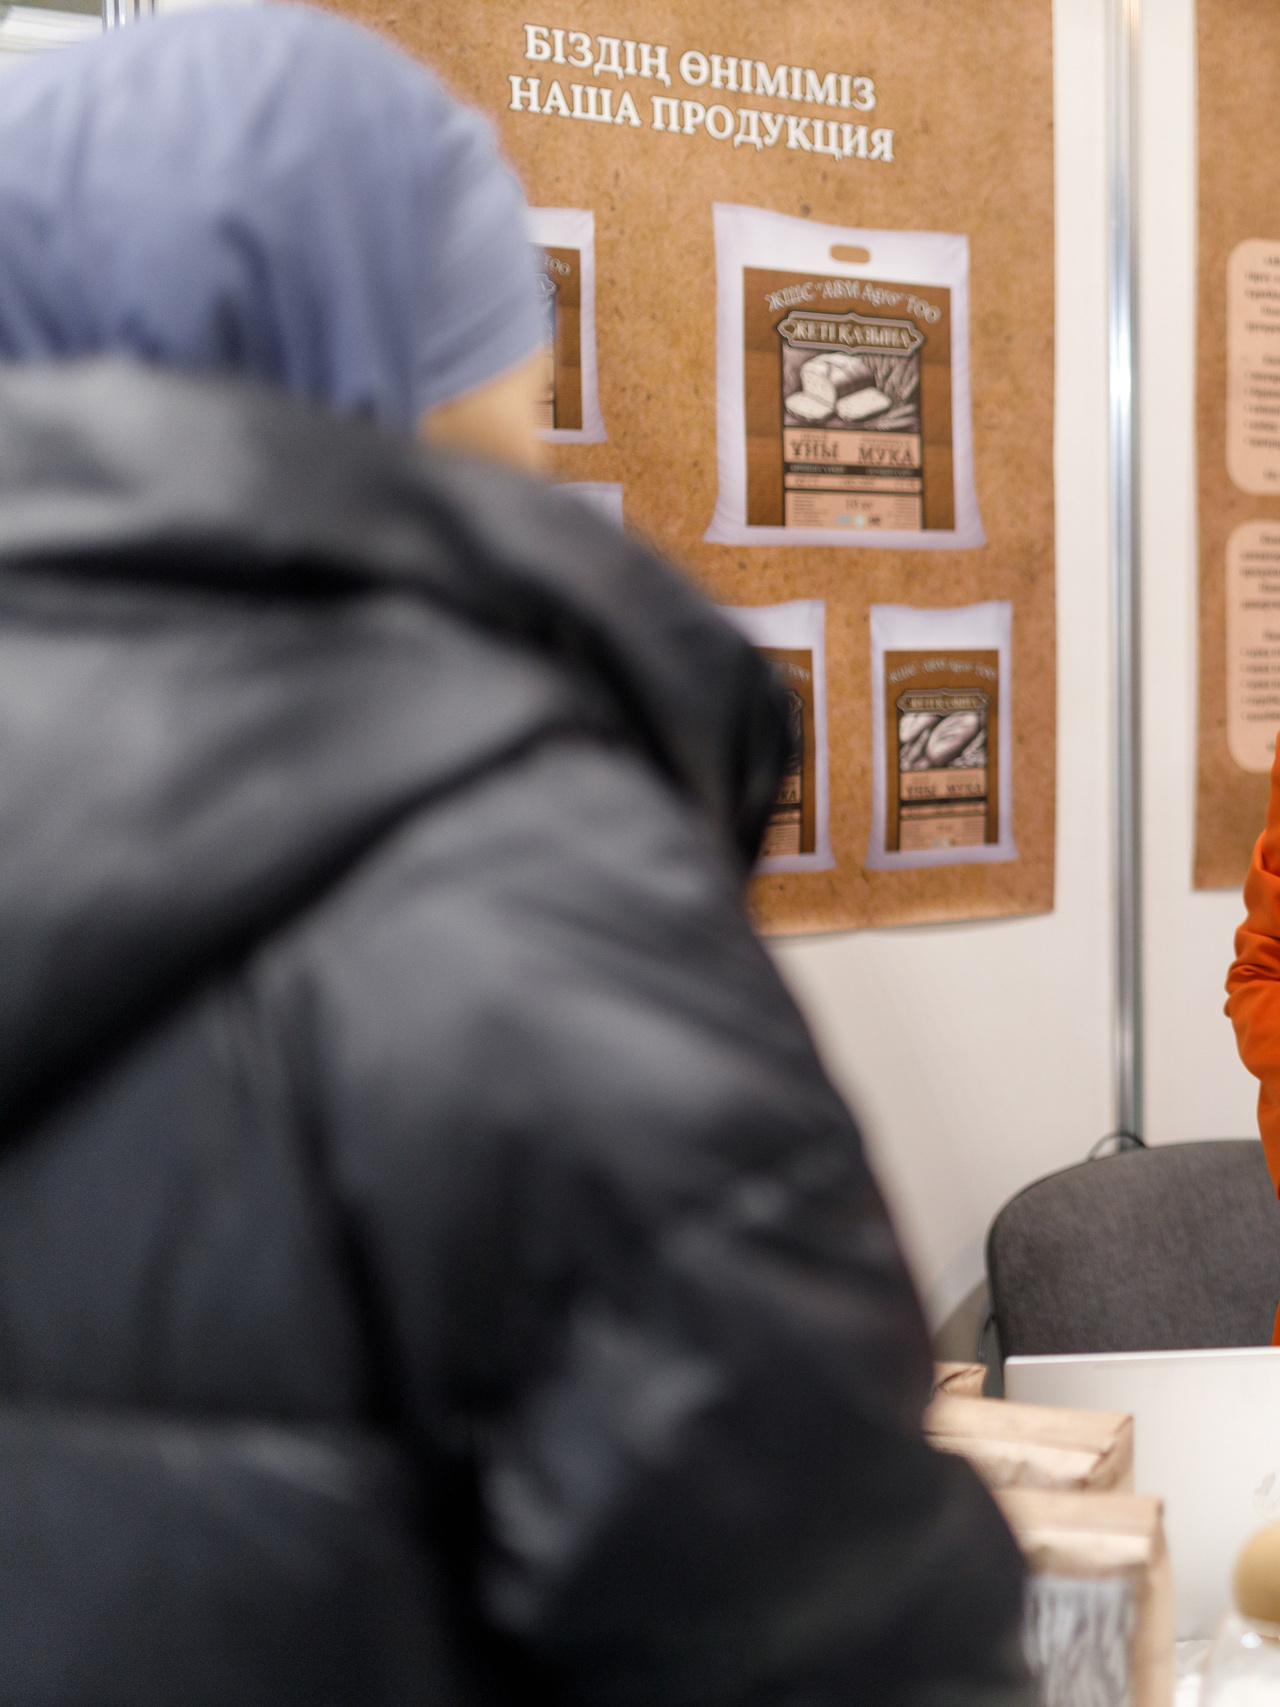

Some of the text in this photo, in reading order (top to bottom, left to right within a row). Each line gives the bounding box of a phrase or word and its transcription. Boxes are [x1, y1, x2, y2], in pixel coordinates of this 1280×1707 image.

[524, 23, 876, 111] БІЗДІҢ ӨНІМІМІЗ
[508, 74, 895, 162] НАША ПРОДУКЦИЯ
[906, 294, 941, 325] ТОО
